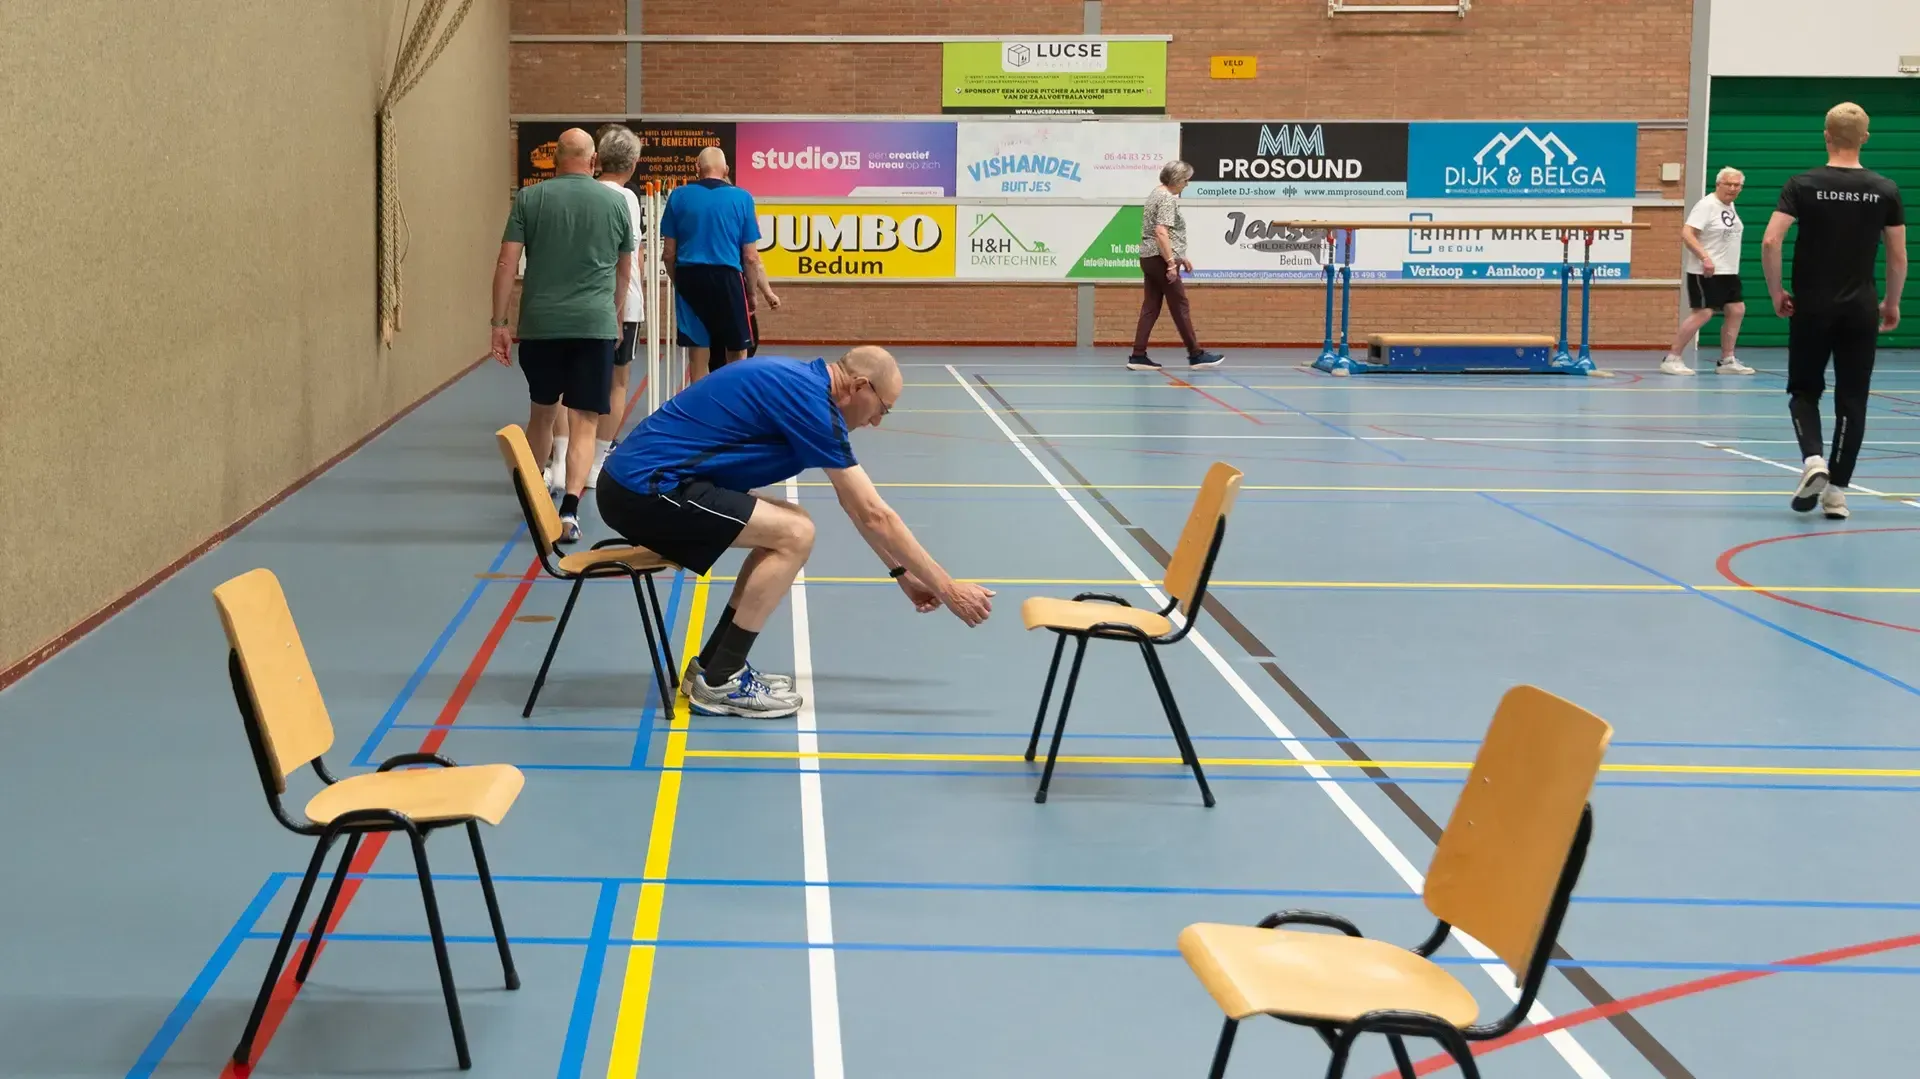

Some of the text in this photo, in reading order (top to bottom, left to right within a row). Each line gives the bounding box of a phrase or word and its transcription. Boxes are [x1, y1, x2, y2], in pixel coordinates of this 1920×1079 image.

[1037, 44, 1102, 57] LUCSE
[661, 137, 721, 147] GEMEENTEHUIS
[1257, 124, 1325, 157] MM
[868, 150, 930, 160] een creatief
[1104, 153, 1115, 161] 06
[1116, 153, 1127, 161] 44
[1141, 153, 1151, 161] 25
[1153, 153, 1164, 161] 25
[868, 160, 941, 170] bureau op zich
[967, 154, 1082, 183] VISHANDEL
[1218, 158, 1363, 179] PROSOUND
[1445, 166, 1606, 186] DIJK & BELGA
[1197, 187, 1404, 197] Complete DJ-show www.mmprosound.com
[1816, 190, 1880, 203] ELDERS FIT
[757, 214, 942, 253] JUMBO
[971, 238, 1011, 253] H&H
[1111, 244, 1123, 253] Tel.
[1438, 245, 1484, 253] BEDUM
[798, 256, 883, 275] Bedum
[971, 255, 1058, 266] DAKTECHNIEK
[1083, 258, 1141, 267] info@henhdakte
[1280, 254, 1312, 266] Bedum
[1409, 265, 1463, 279] Verkoop
[1485, 265, 1545, 279] Aankoop
